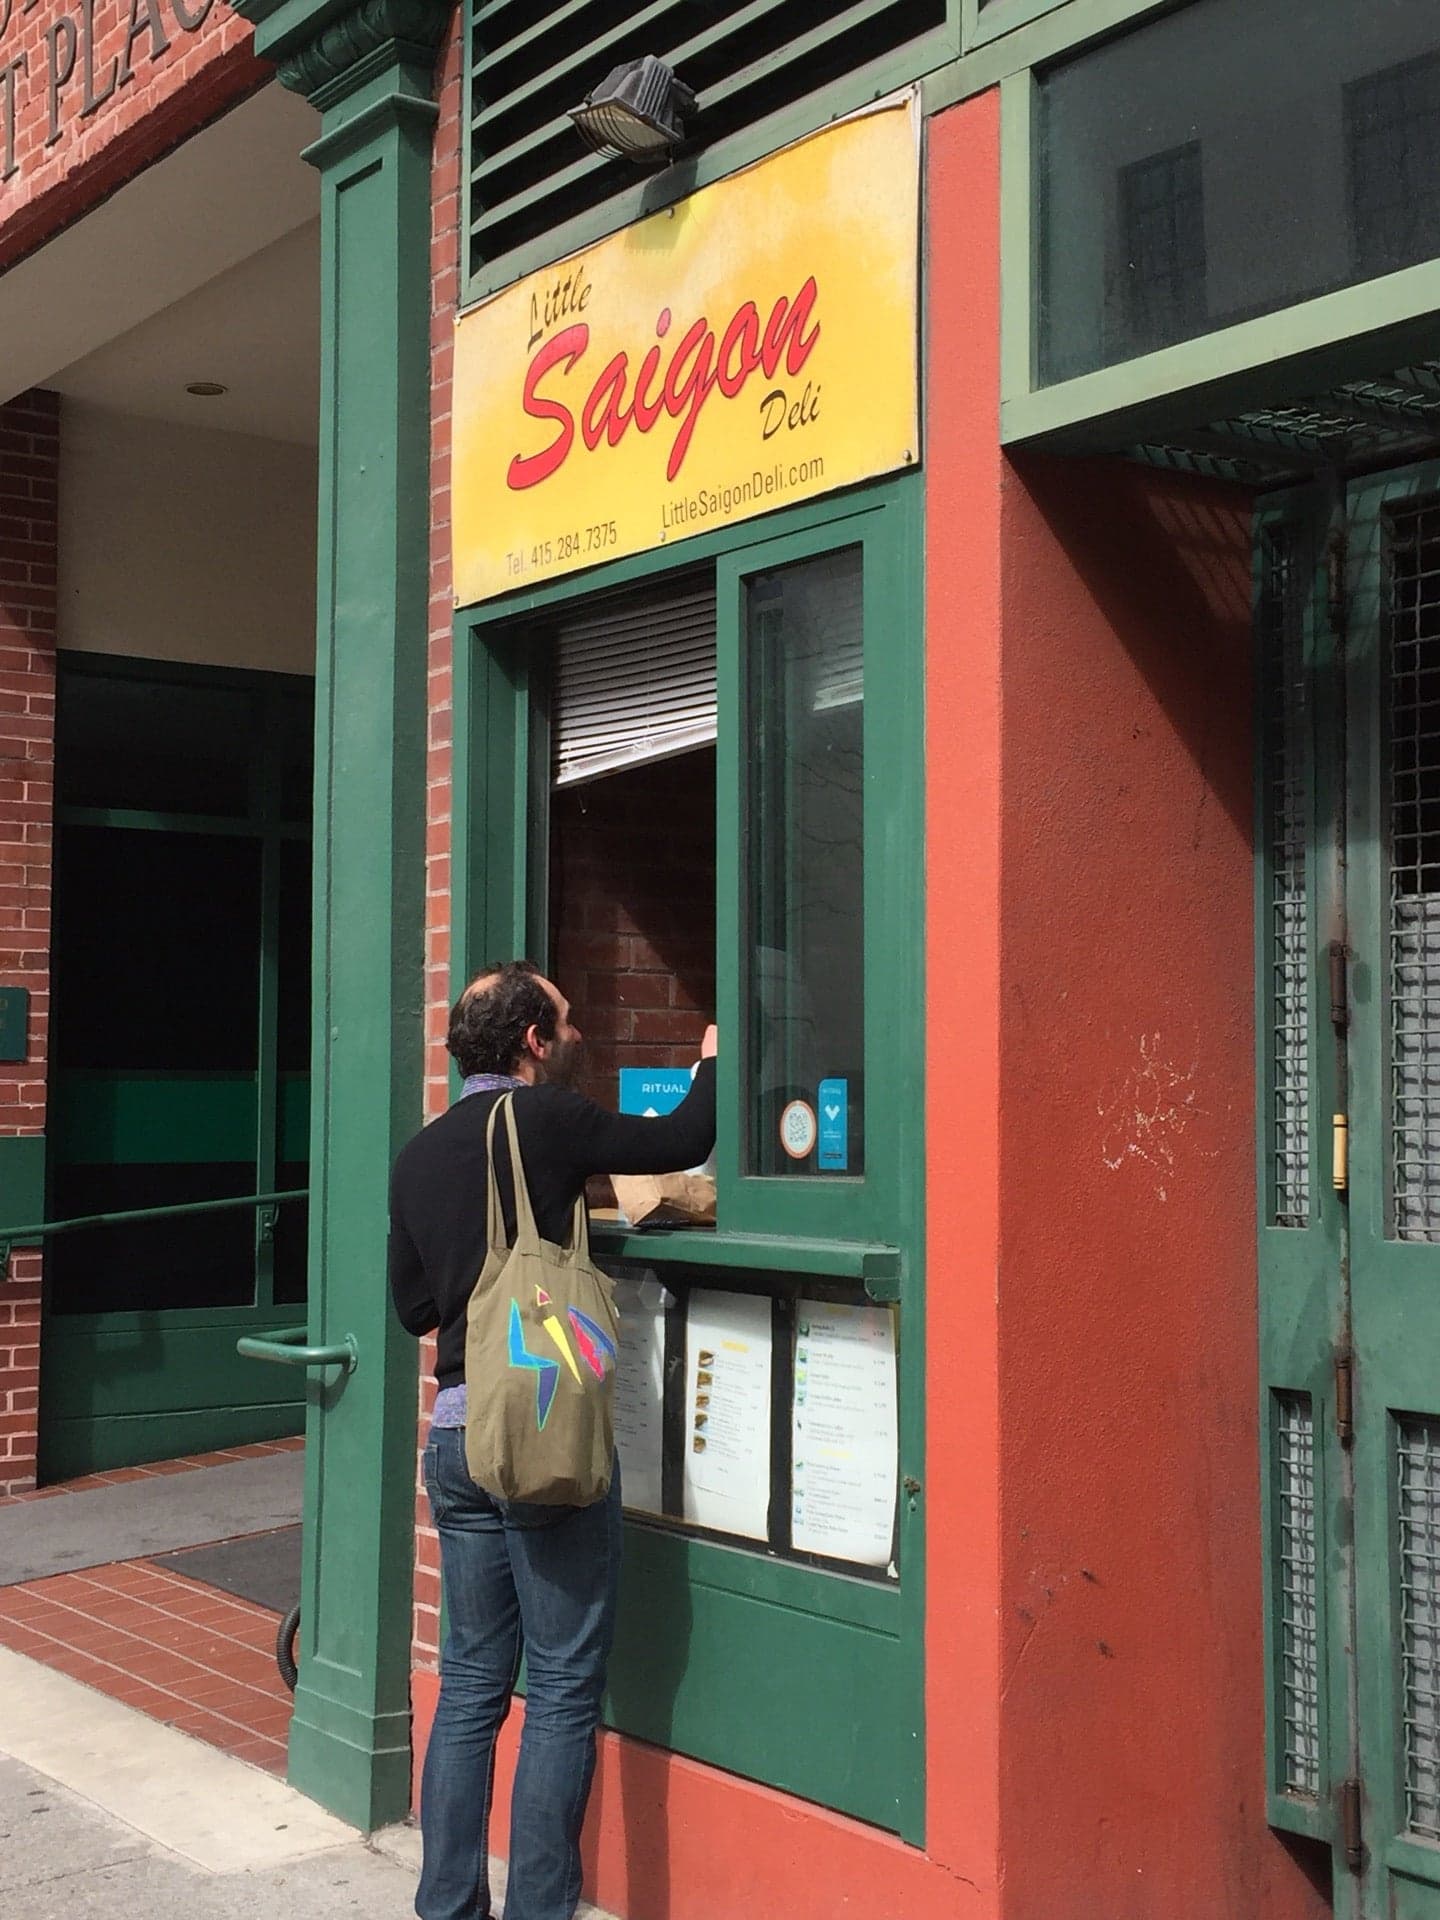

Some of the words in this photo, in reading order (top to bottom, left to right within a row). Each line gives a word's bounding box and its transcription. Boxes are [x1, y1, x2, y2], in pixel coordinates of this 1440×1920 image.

[528, 266, 592, 352] Little
[506, 276, 820, 490] Saigon
[759, 385, 821, 441] Deli
[662, 455, 824, 529] LittleSaigonDeli.com
[532, 520, 617, 567] 415.284.7375
[642, 1084, 686, 1093] RITUAL
